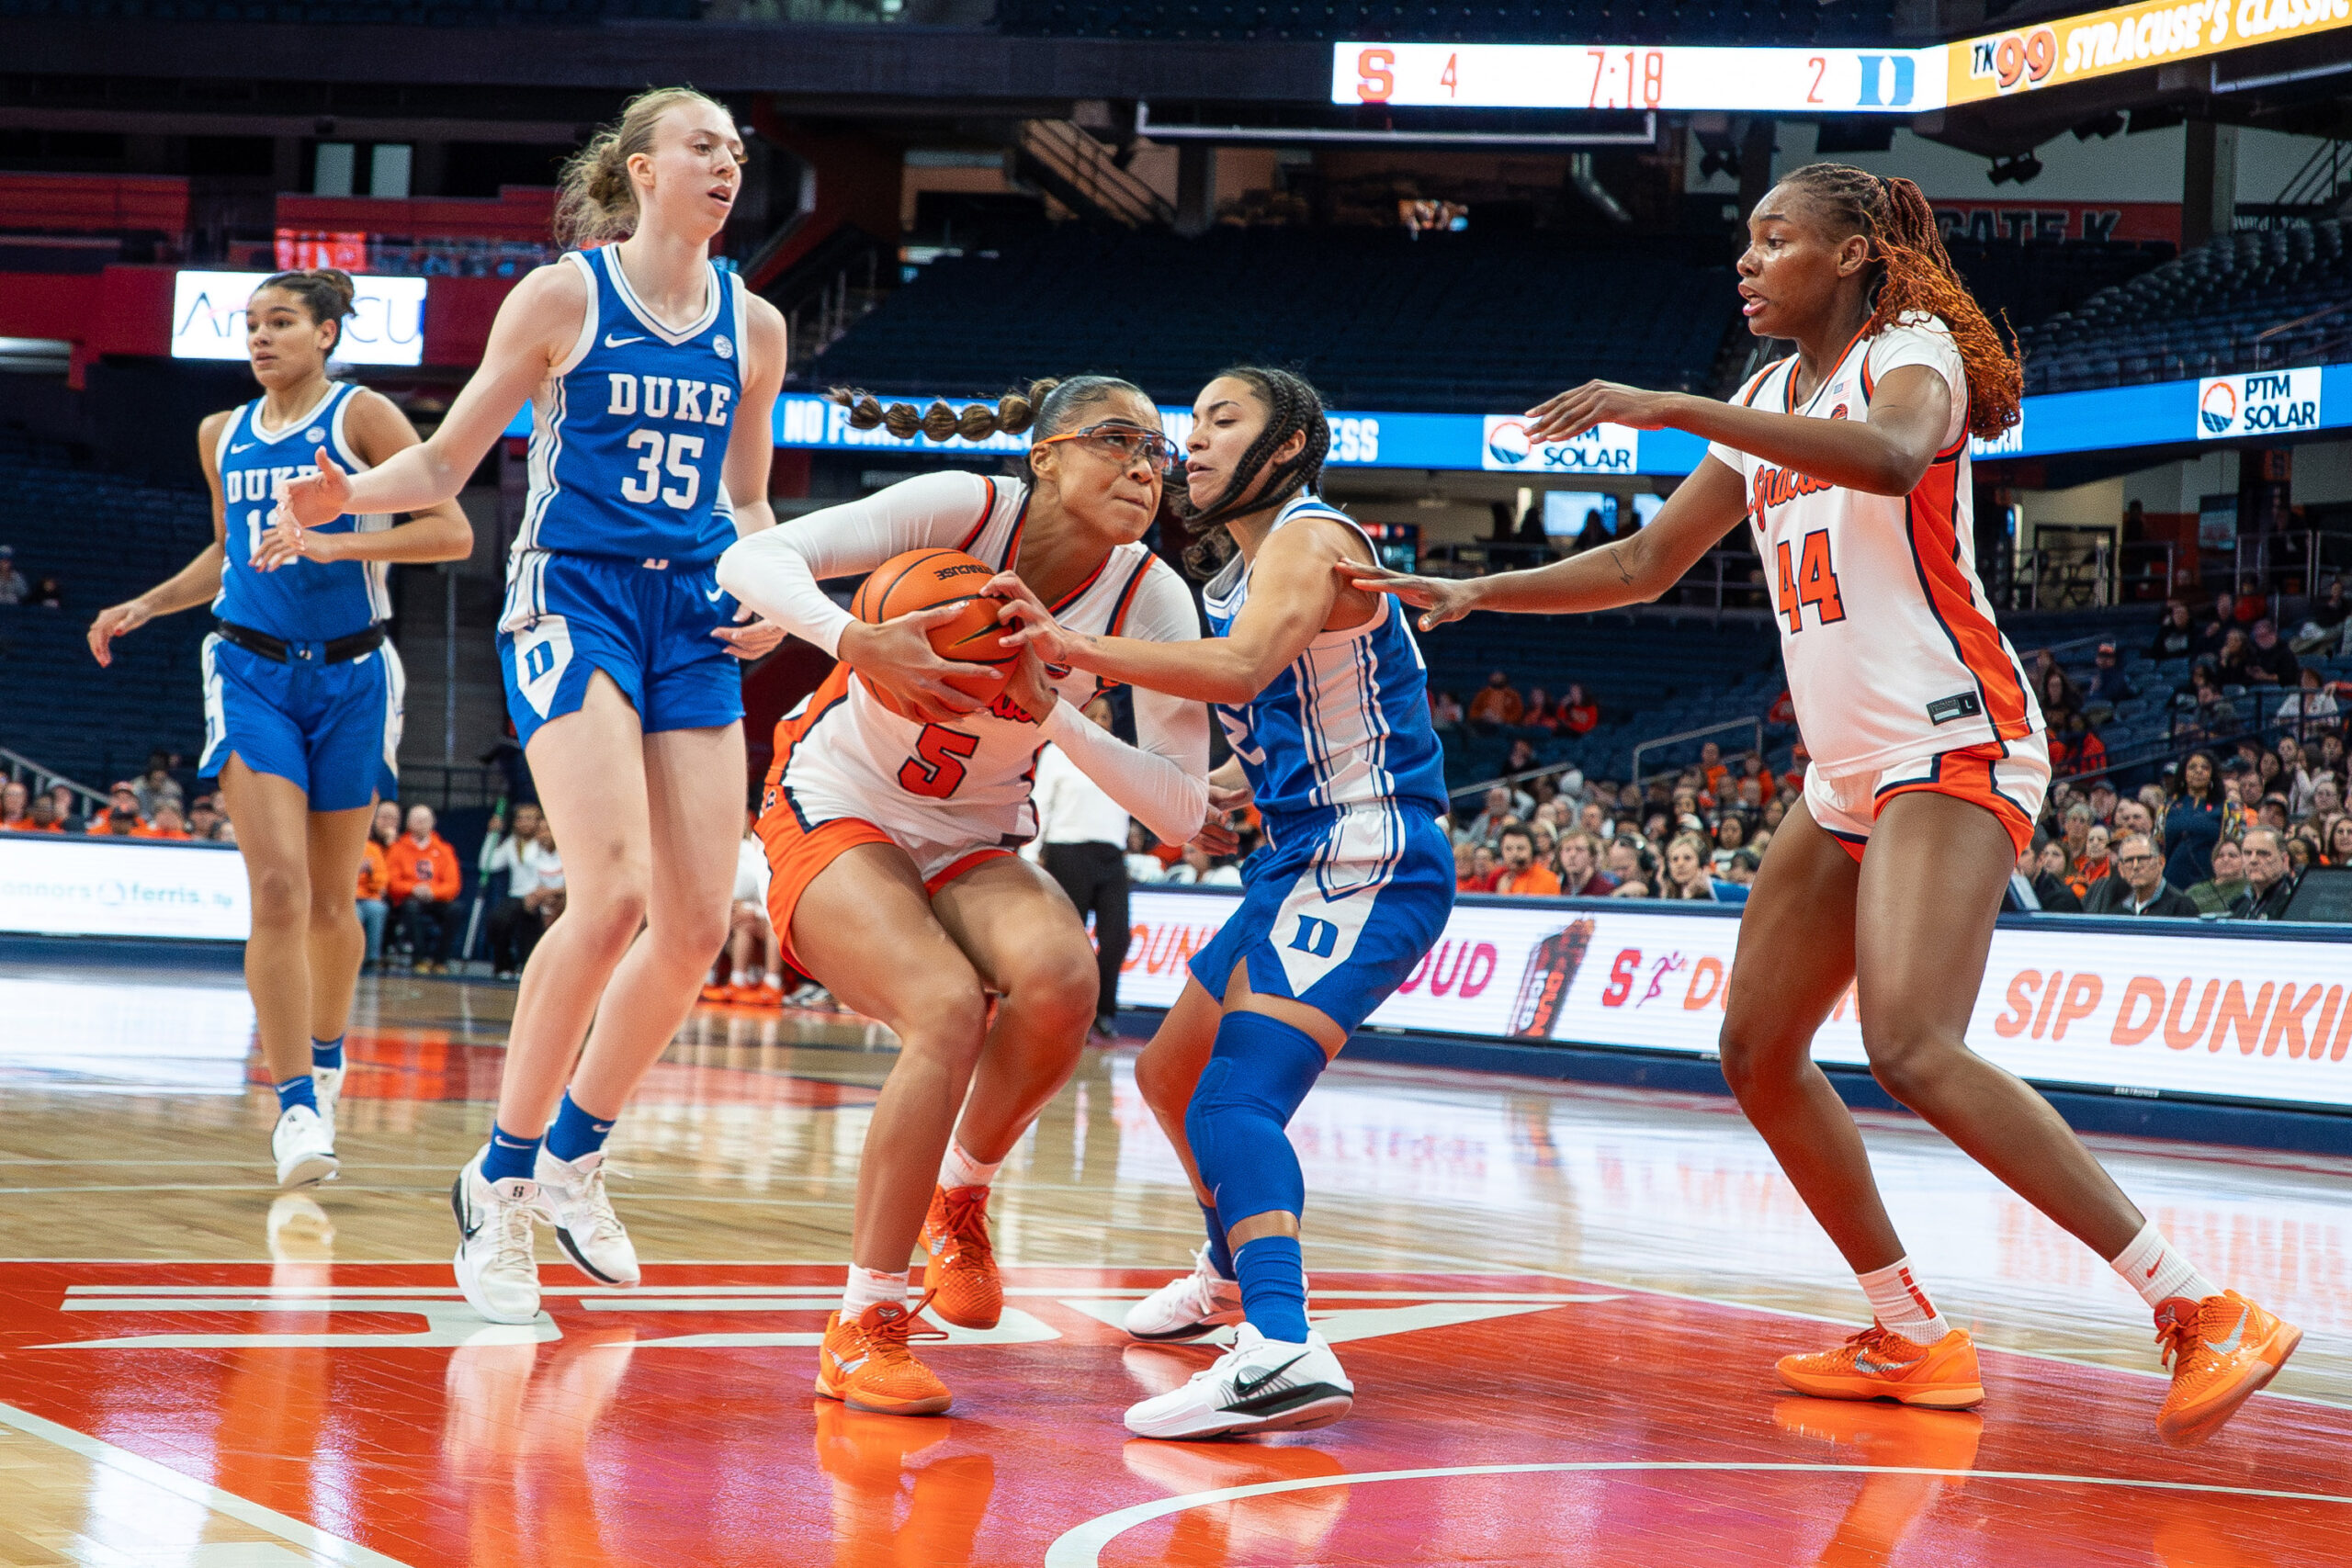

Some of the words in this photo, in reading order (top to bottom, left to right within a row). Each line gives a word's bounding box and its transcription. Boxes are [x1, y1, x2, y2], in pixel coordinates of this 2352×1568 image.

[2064, 0, 2230, 73] SYRACUSE'S
[1441, 53, 1457, 97] 4
[1588, 51, 1664, 107] 7:18
[1806, 58, 1826, 103] 2
[608, 373, 731, 426] DUKE
[2245, 375, 2290, 401] PTM
[2245, 400, 2315, 430] SOLAR
[621, 429, 705, 511] 35
[1544, 446, 1630, 468] SOLAR
[1777, 527, 1847, 635] 44
[898, 722, 979, 799] 5
[1120, 923, 1219, 976] DUN
[1995, 969, 2104, 1042] SIP
